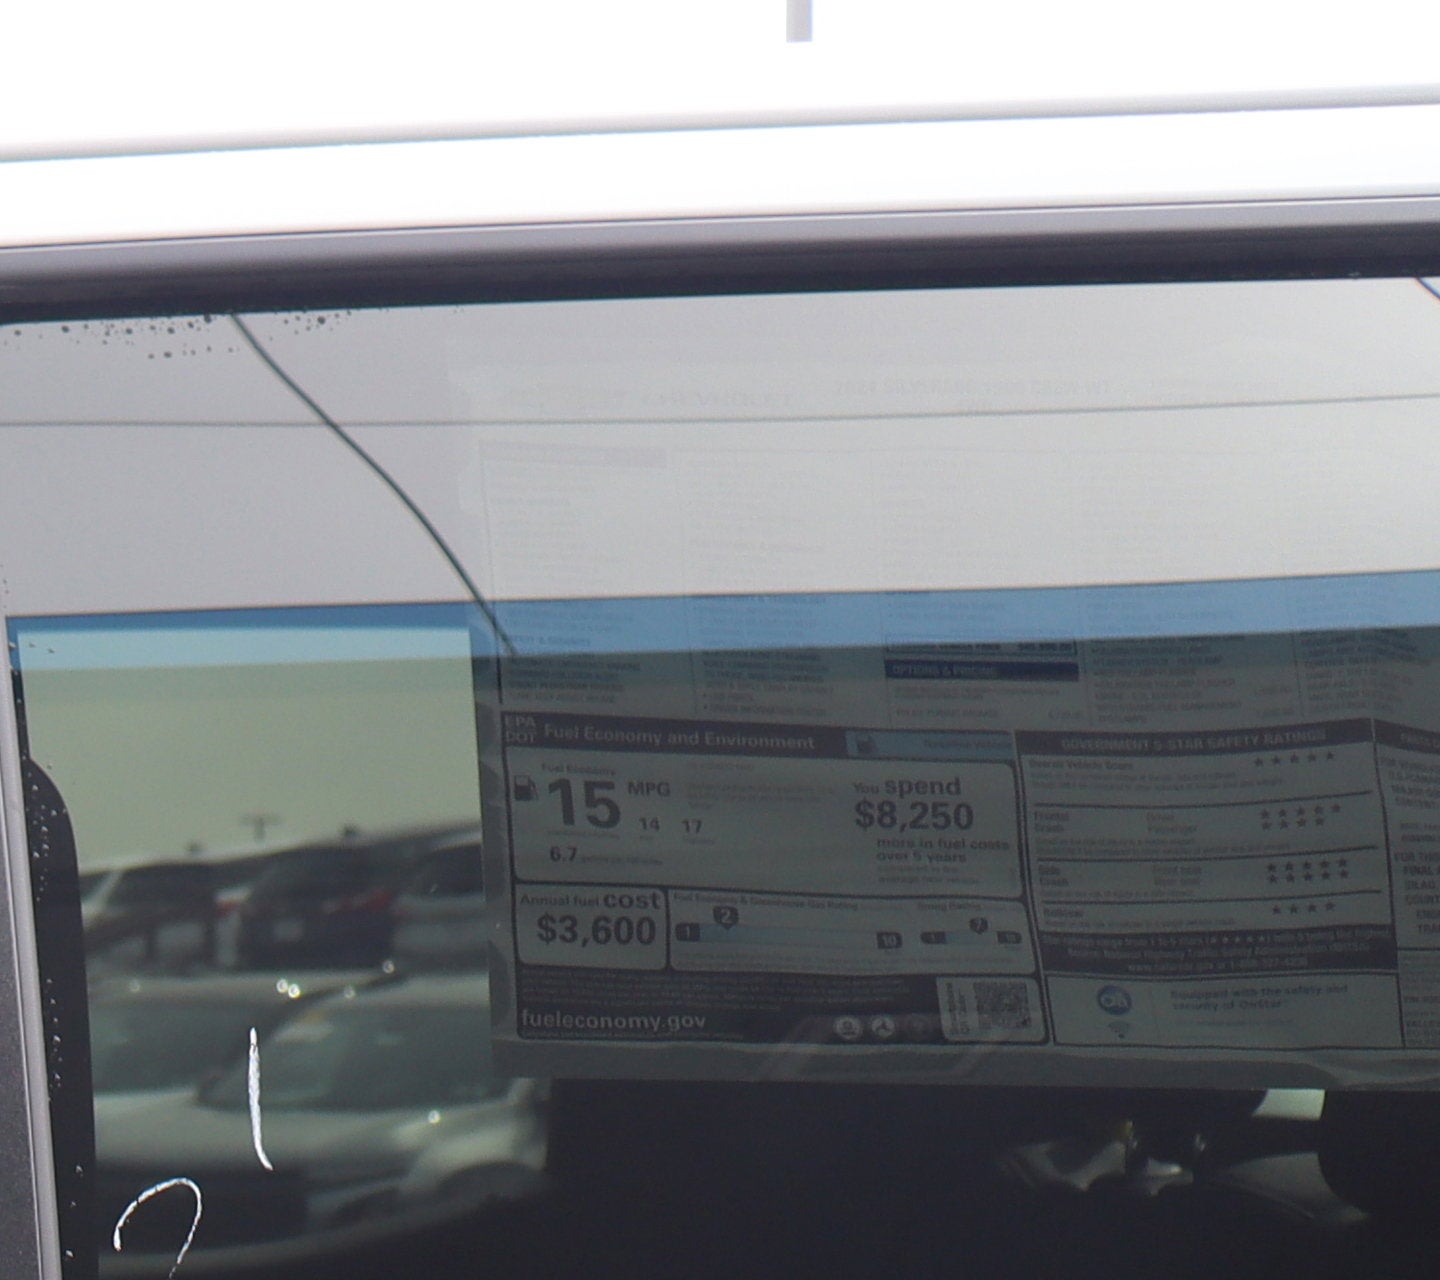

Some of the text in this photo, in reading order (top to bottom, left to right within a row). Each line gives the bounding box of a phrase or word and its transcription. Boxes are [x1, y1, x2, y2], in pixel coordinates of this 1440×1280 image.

[504, 715, 537, 728] EPA
[544, 722, 815, 750] Fuel Economy and Environment
[627, 780, 672, 798] MPG
[852, 776, 962, 799] You spend
[547, 777, 622, 829] 15
[638, 816, 661, 832] 14
[854, 796, 975, 834] $8,250
[680, 818, 703, 834] 17
[549, 845, 578, 863] 6.7
[520, 891, 662, 911] Annual fuel cost
[720, 908, 731, 924] 2
[536, 911, 657, 947] $3,600
[521, 1008, 707, 1033] fueleconomy.gov
